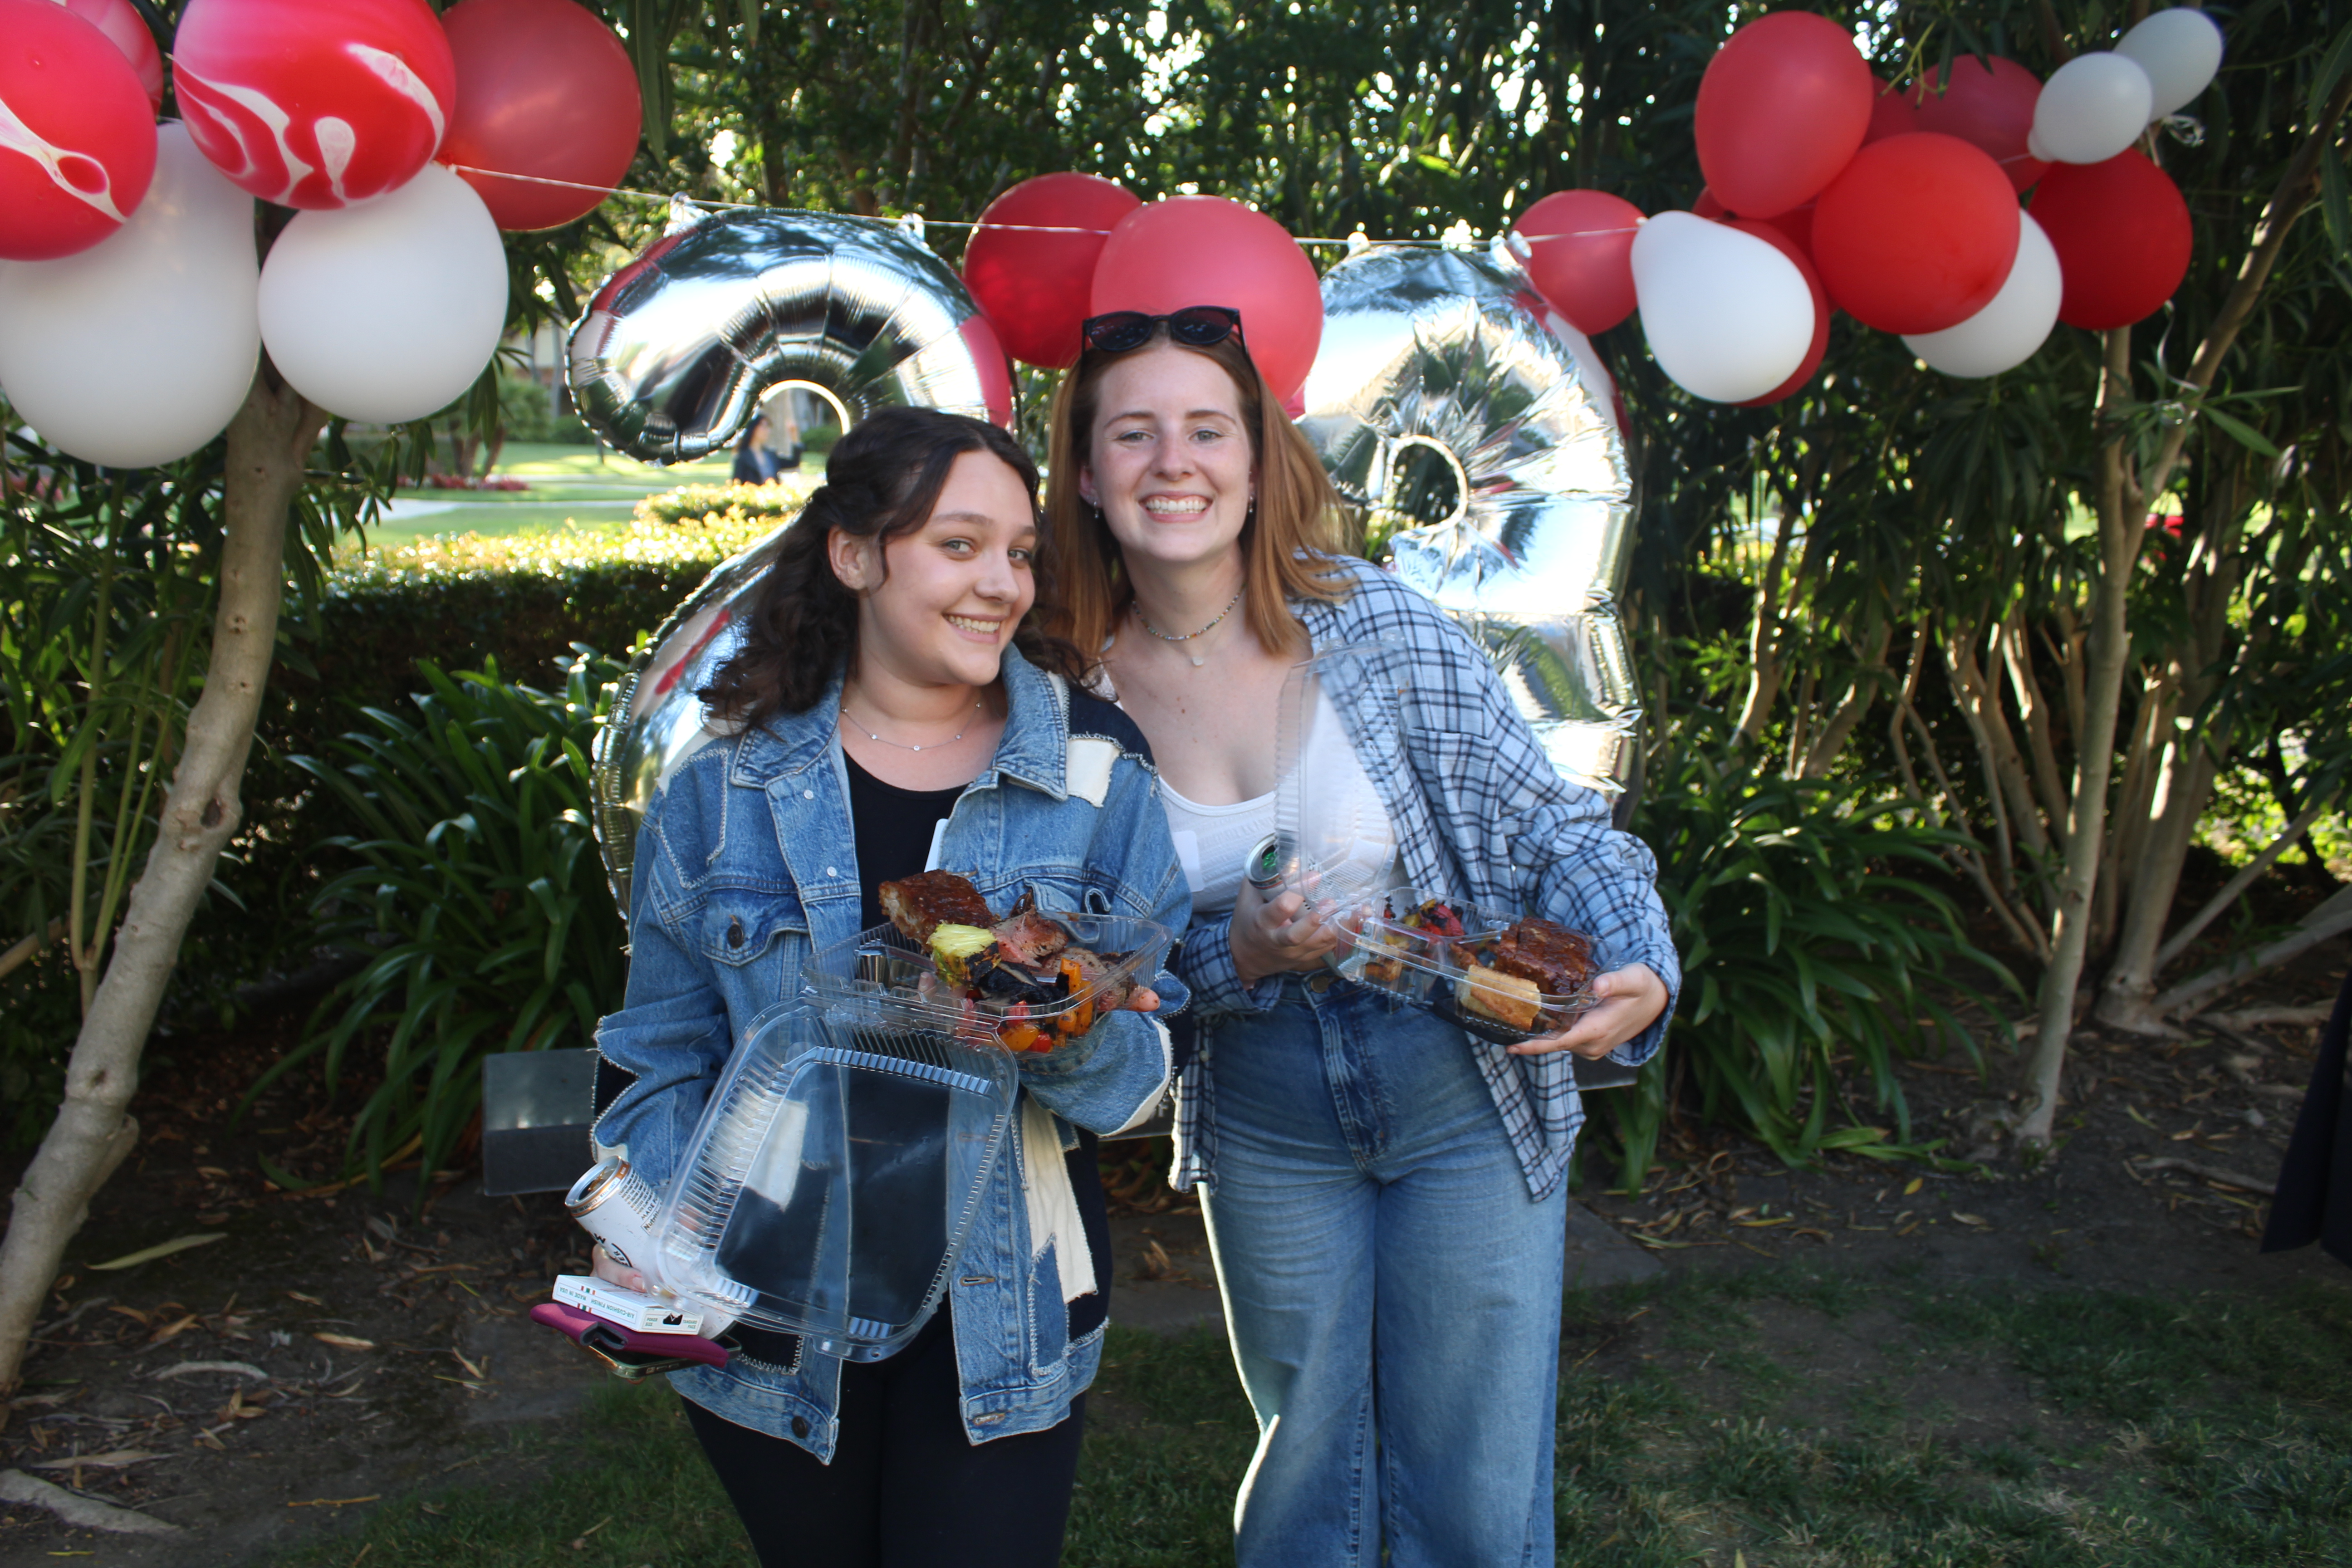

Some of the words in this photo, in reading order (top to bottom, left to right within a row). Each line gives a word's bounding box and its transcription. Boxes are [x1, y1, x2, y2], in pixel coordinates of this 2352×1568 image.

[639, 1203, 655, 1220] MADE
[574, 1292, 587, 1300] MADE
[590, 1298, 606, 1307] FINISH
[606, 1304, 635, 1318] AIR-CUSHION
